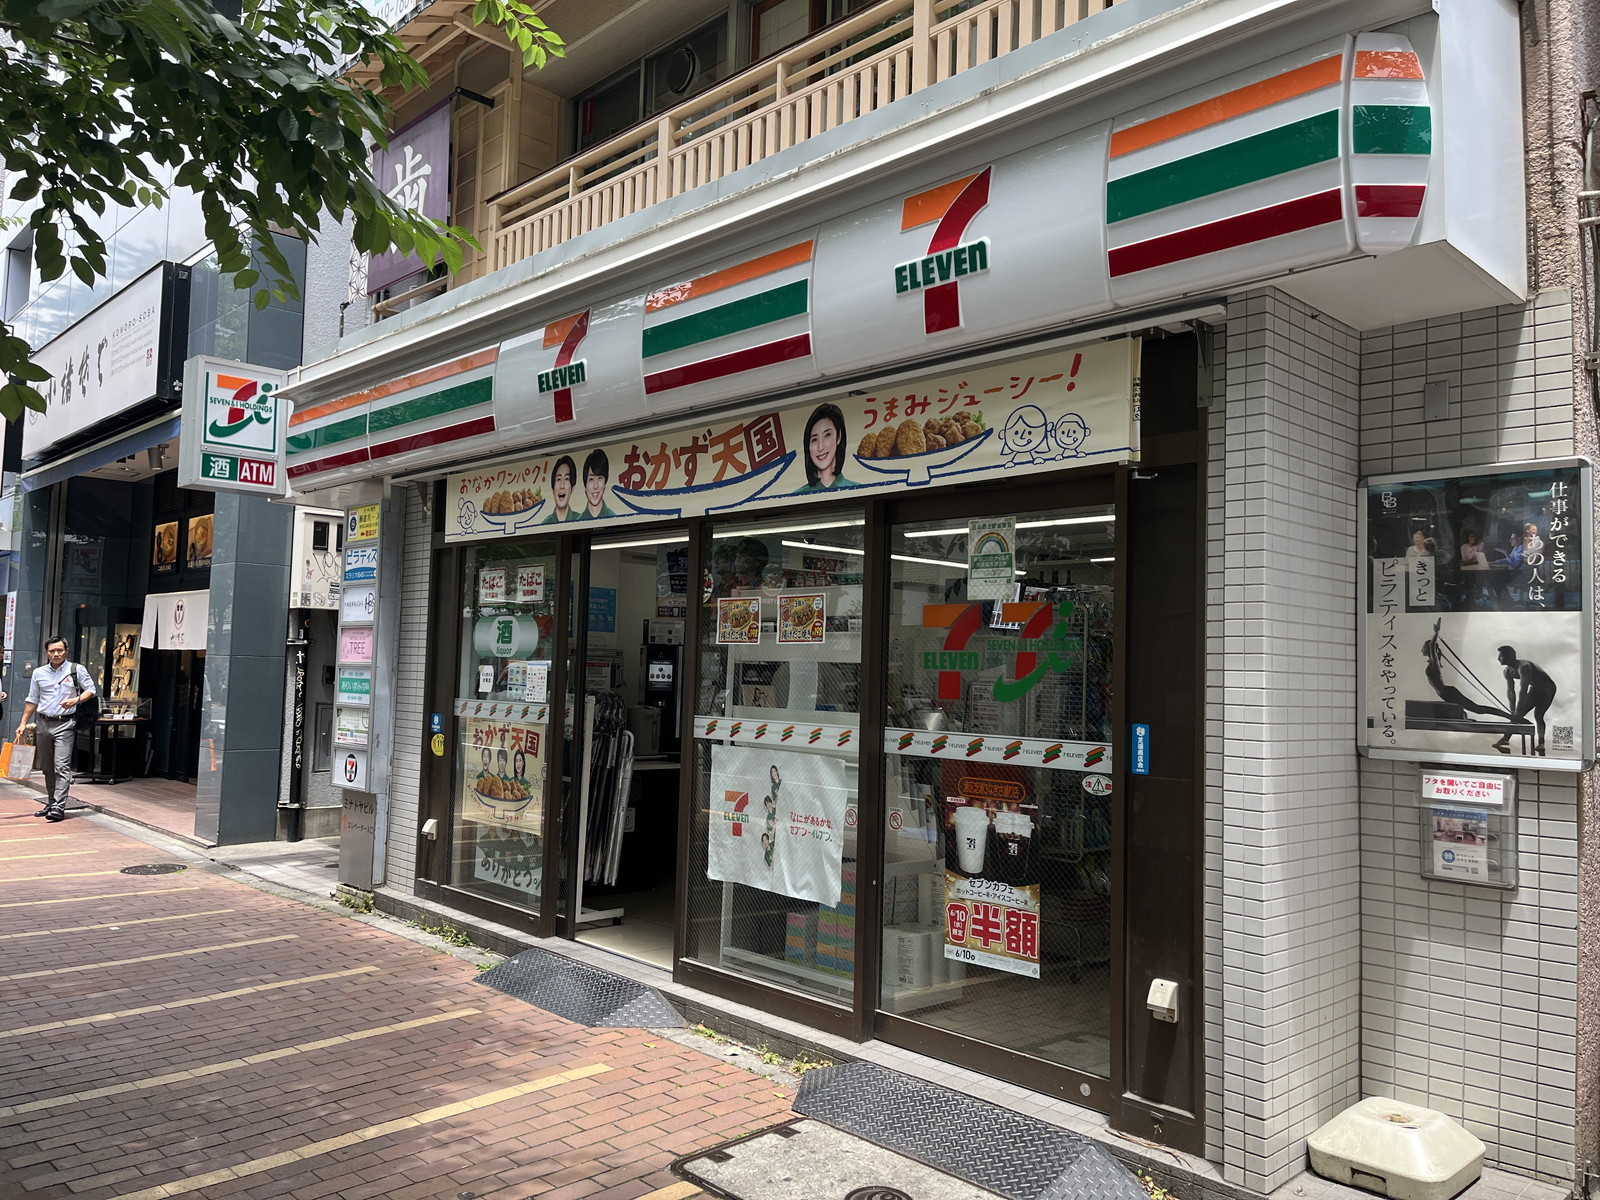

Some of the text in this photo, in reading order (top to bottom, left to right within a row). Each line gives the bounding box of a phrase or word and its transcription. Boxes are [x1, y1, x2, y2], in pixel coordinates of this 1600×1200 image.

[863, 352, 1083, 430] うまみジューシー!
[239, 401, 273, 413] HOLDINGS
[618, 411, 787, 491] おかず天国
[209, 456, 274, 486] 酒 ATM
[1549, 481, 1569, 583] 仕事ができる
[346, 548, 378, 566] ピラティス
[481, 575, 504, 591] たばこ
[519, 572, 543, 588] たばこ
[1415, 560, 1431, 602] きっと
[1527, 533, 1546, 608] あの人は、
[496, 619, 514, 645] 酒
[350, 641, 366, 655] TREE
[1378, 557, 1398, 746] ピラティスをやっている。
[472, 723, 540, 759] おかず天国
[1424, 777, 1502, 790] フタを開いてご自由に
[1435, 787, 1490, 798] お取りください
[343, 798, 375, 815] ミナトヤビル
[968, 878, 1015, 895] セブンカフェ
[970, 902, 1039, 959] 半額
